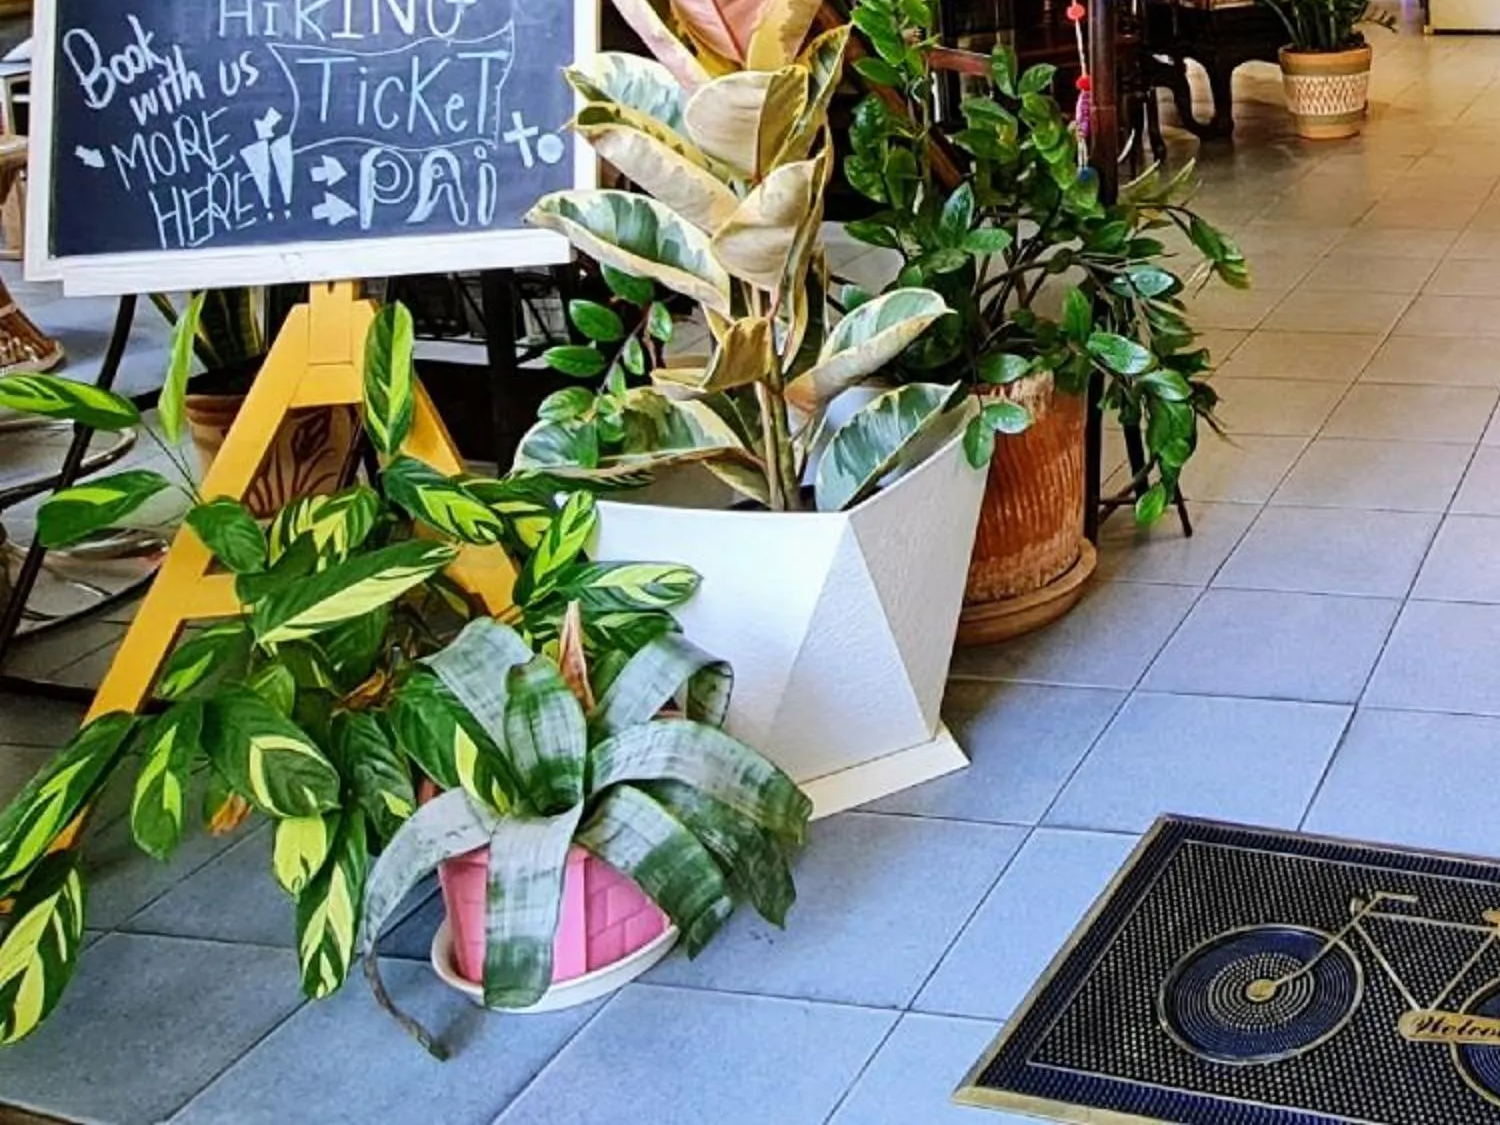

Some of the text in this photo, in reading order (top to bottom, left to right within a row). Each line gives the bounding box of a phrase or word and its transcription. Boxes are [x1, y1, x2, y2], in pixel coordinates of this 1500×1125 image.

[63, 14, 154, 110] Book
[129, 45, 205, 125] with
[111, 107, 234, 192] MORE
